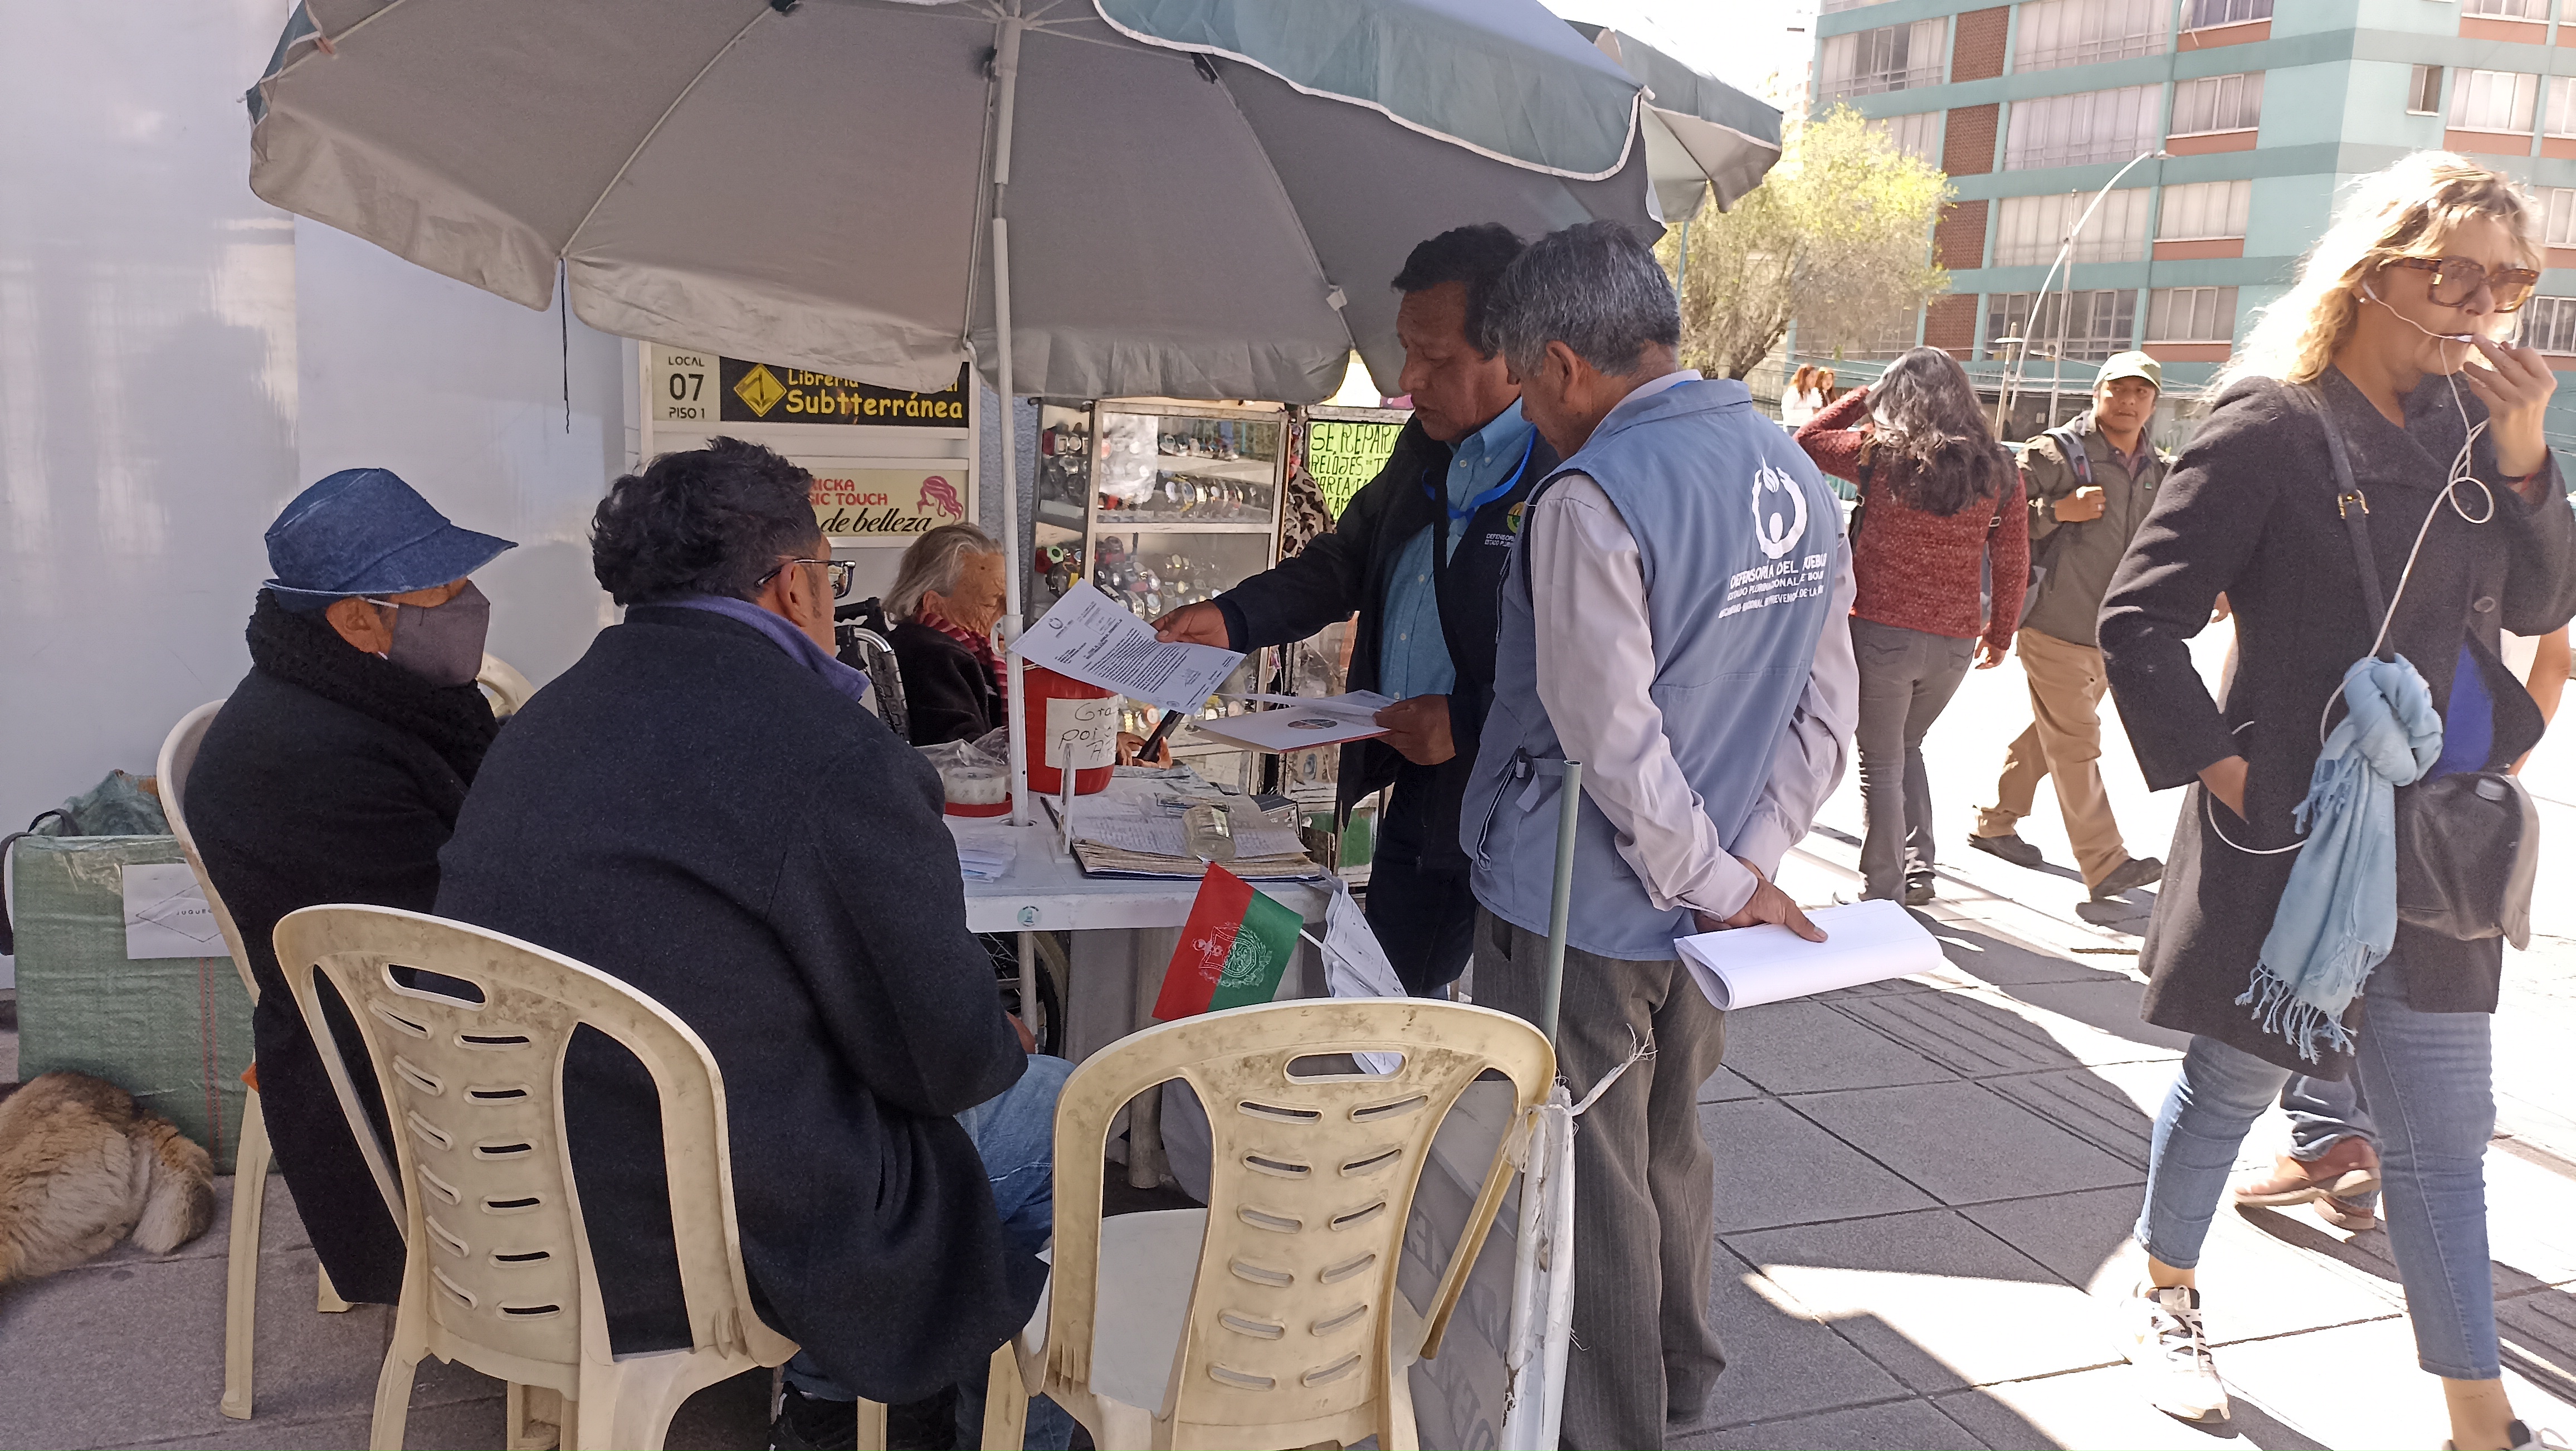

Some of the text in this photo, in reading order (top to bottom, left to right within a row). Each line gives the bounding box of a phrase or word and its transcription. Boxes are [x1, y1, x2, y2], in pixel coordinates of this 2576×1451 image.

[669, 356, 705, 367] LOCAL
[670, 373, 704, 401] 07
[786, 389, 963, 418] Subtterránea
[669, 407, 705, 419] PISO 1
[836, 493, 888, 505] TOUCH
[821, 508, 932, 532] de belleza
[1776, 560, 1799, 576] DEL
